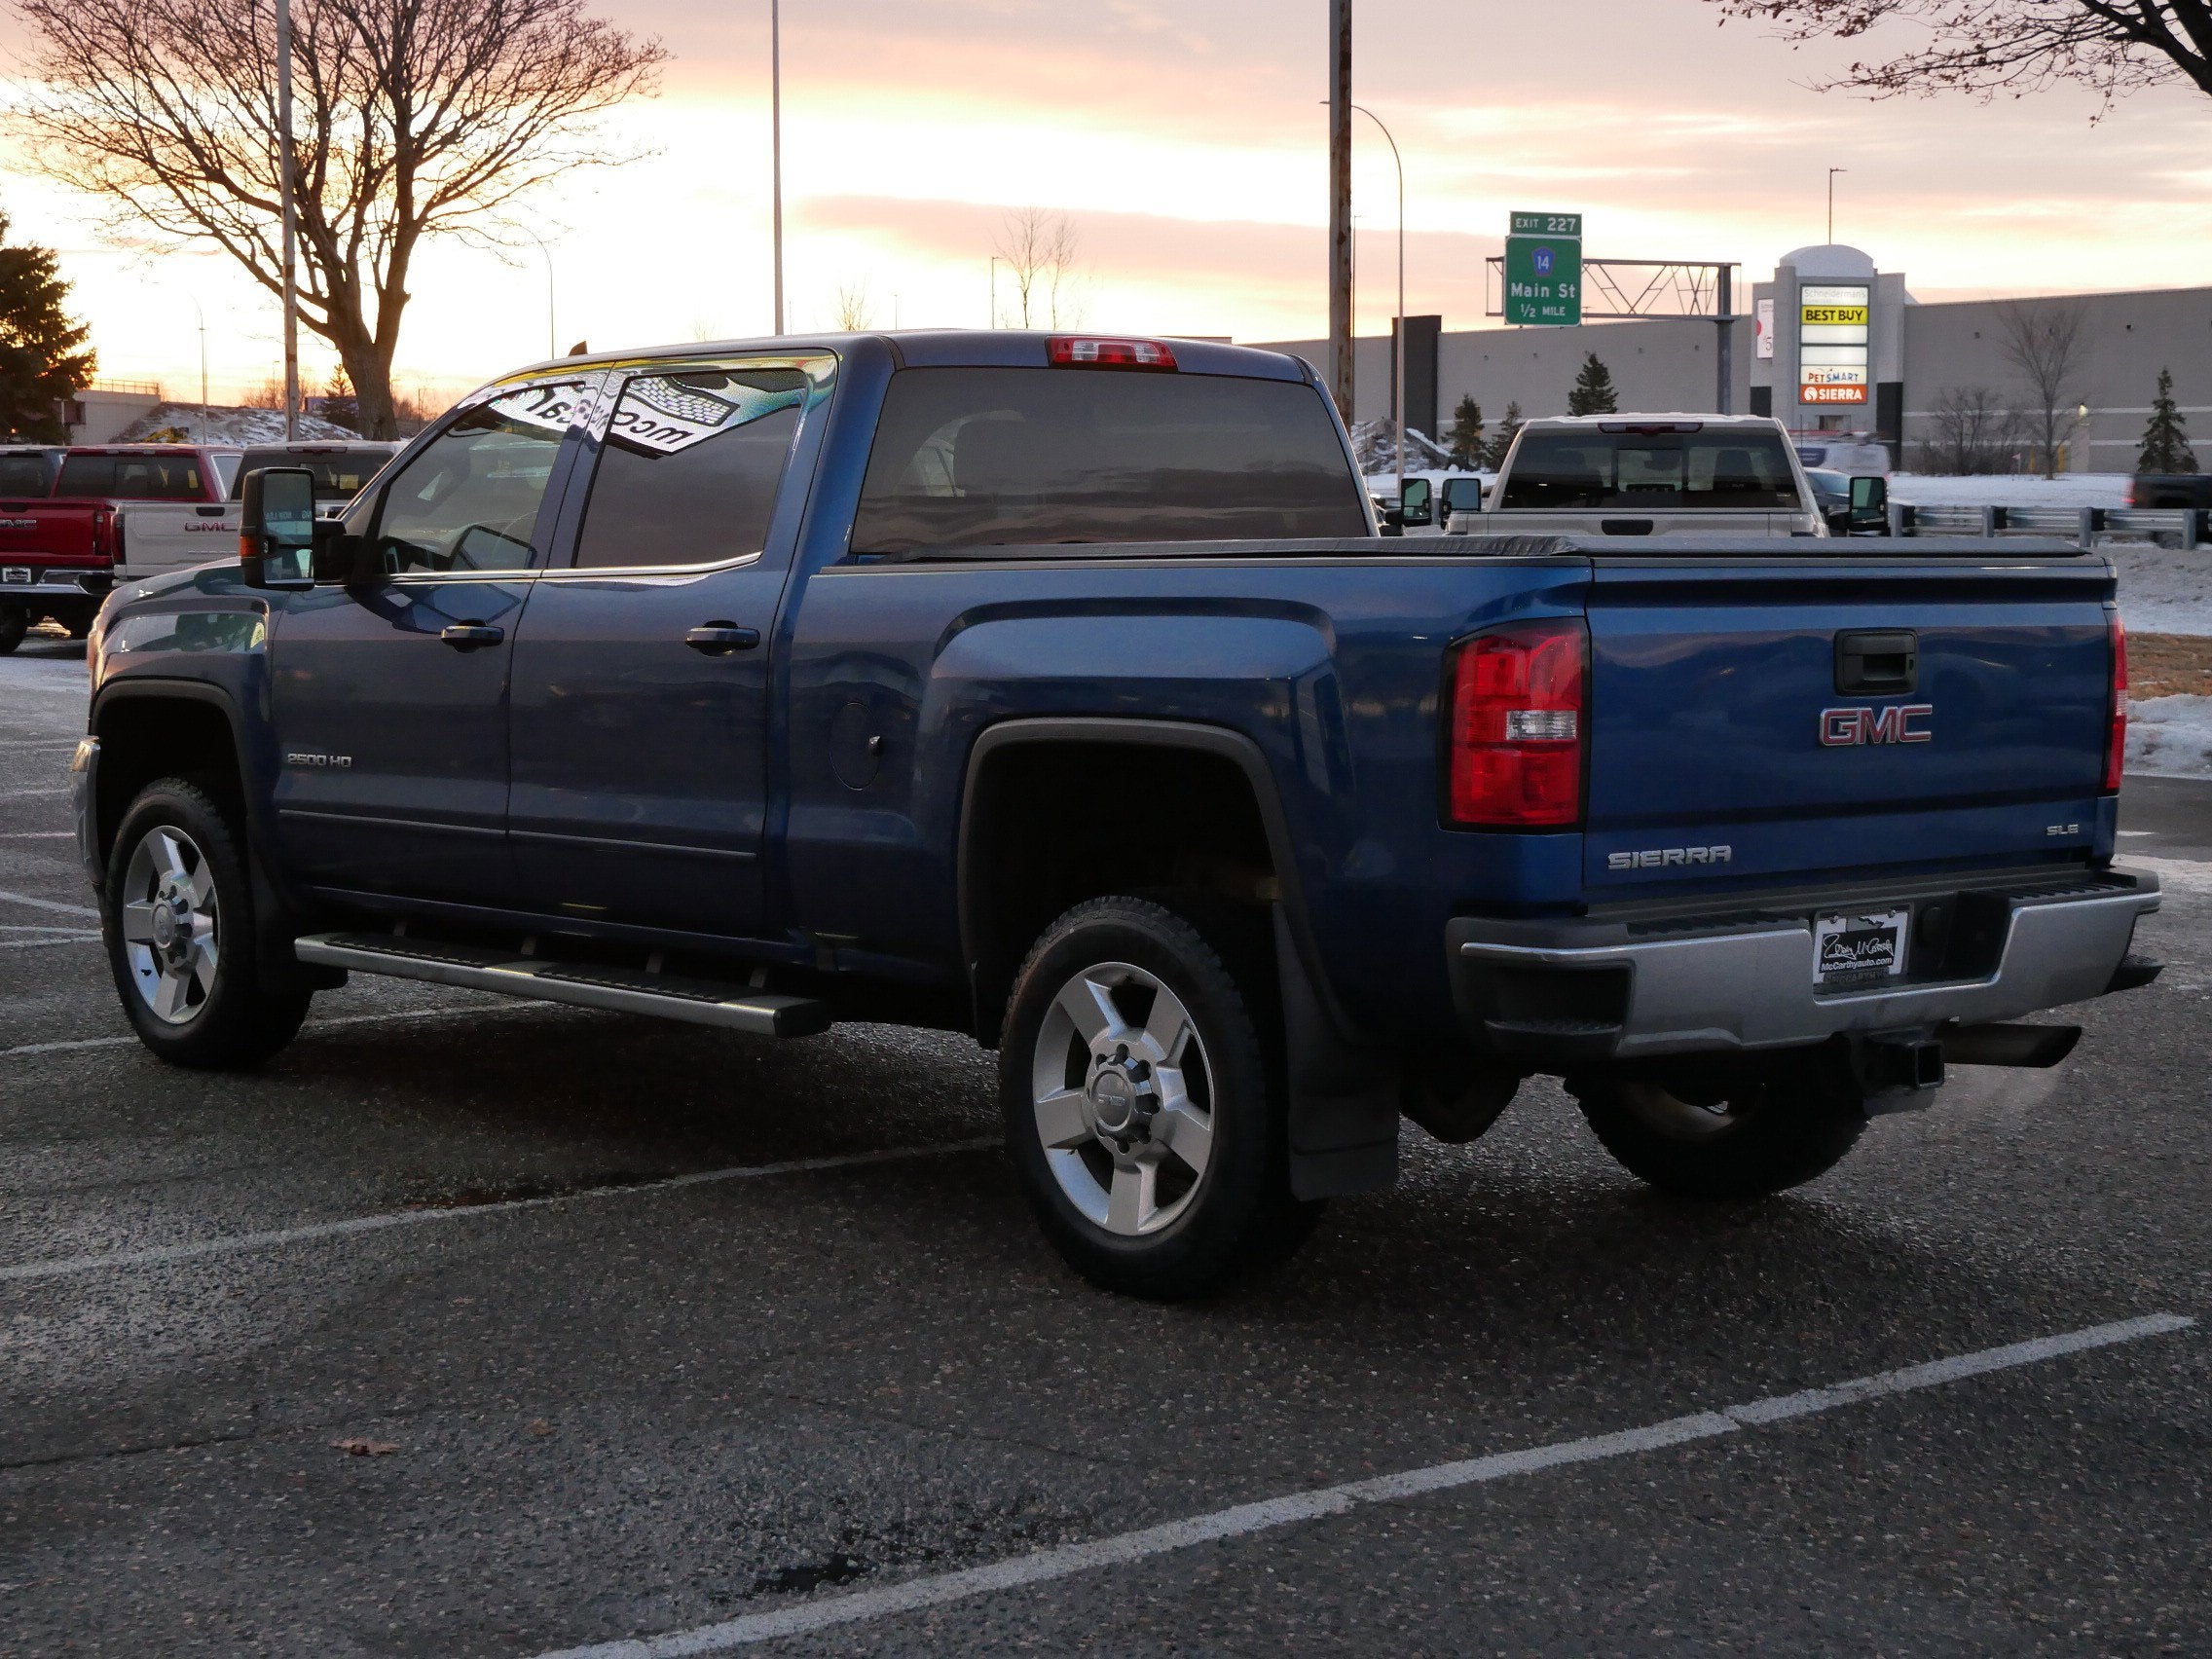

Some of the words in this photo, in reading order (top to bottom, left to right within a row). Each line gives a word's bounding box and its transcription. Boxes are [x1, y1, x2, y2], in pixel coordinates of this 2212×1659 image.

[1516, 218, 1539, 229] EXIT
[1547, 217, 1576, 232] 227
[1537, 255, 1550, 270] 14
[1511, 282, 1550, 297] Main
[1559, 283, 1575, 298] St
[1542, 306, 1566, 315] MILE
[1805, 310, 1835, 321] BEST
[1838, 310, 1863, 321] BUY
[1808, 371, 1859, 383] PETSMART
[1819, 387, 1862, 400] SIERRA
[185, 521, 239, 532] GMC
[1820, 703, 1933, 746] GMC
[288, 753, 326, 766] 2500
[330, 756, 351, 767] HD
[2046, 824, 2079, 836] SLE
[1608, 845, 1732, 869] SIERRA
[1821, 957, 1893, 972] McCarthyauto.com
